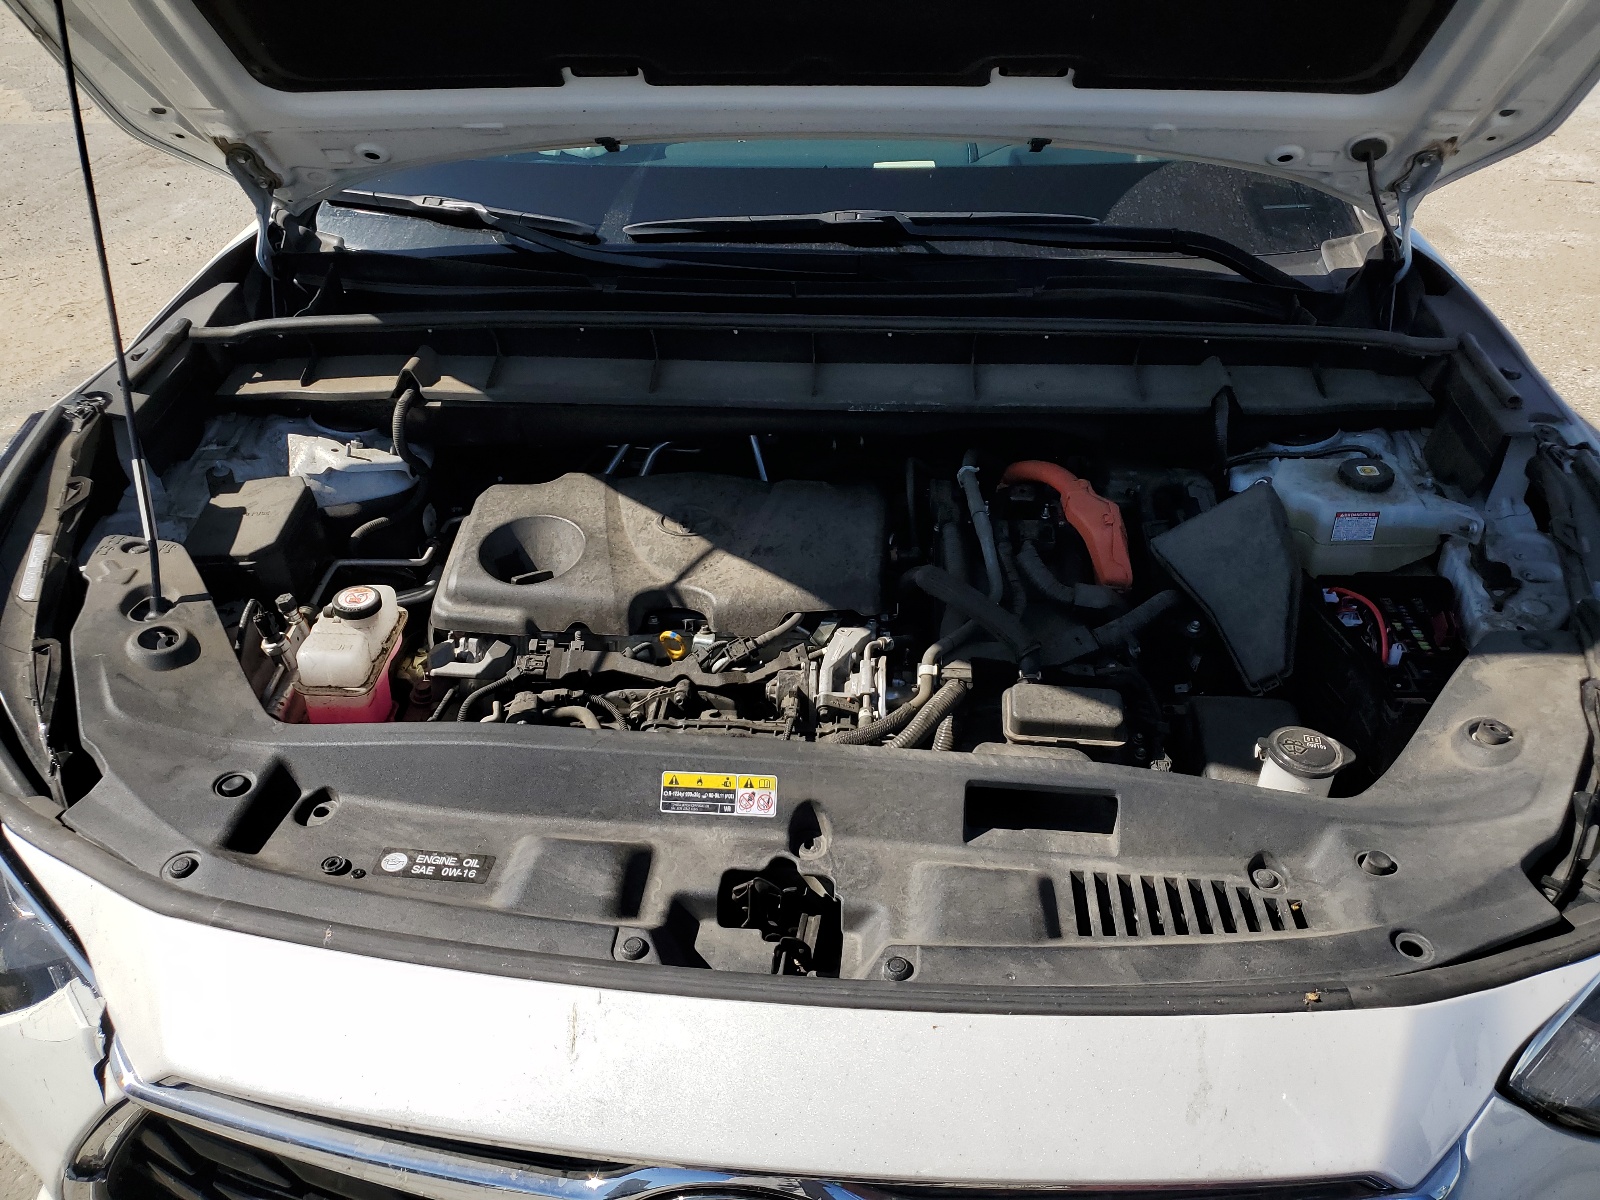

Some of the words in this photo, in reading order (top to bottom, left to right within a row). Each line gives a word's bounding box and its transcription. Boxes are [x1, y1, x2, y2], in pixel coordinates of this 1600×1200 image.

[415, 854, 457, 866] ENGINE
[462, 858, 480, 868] OIL
[411, 864, 435, 875] SAE
[441, 867, 477, 878] 0W-16
